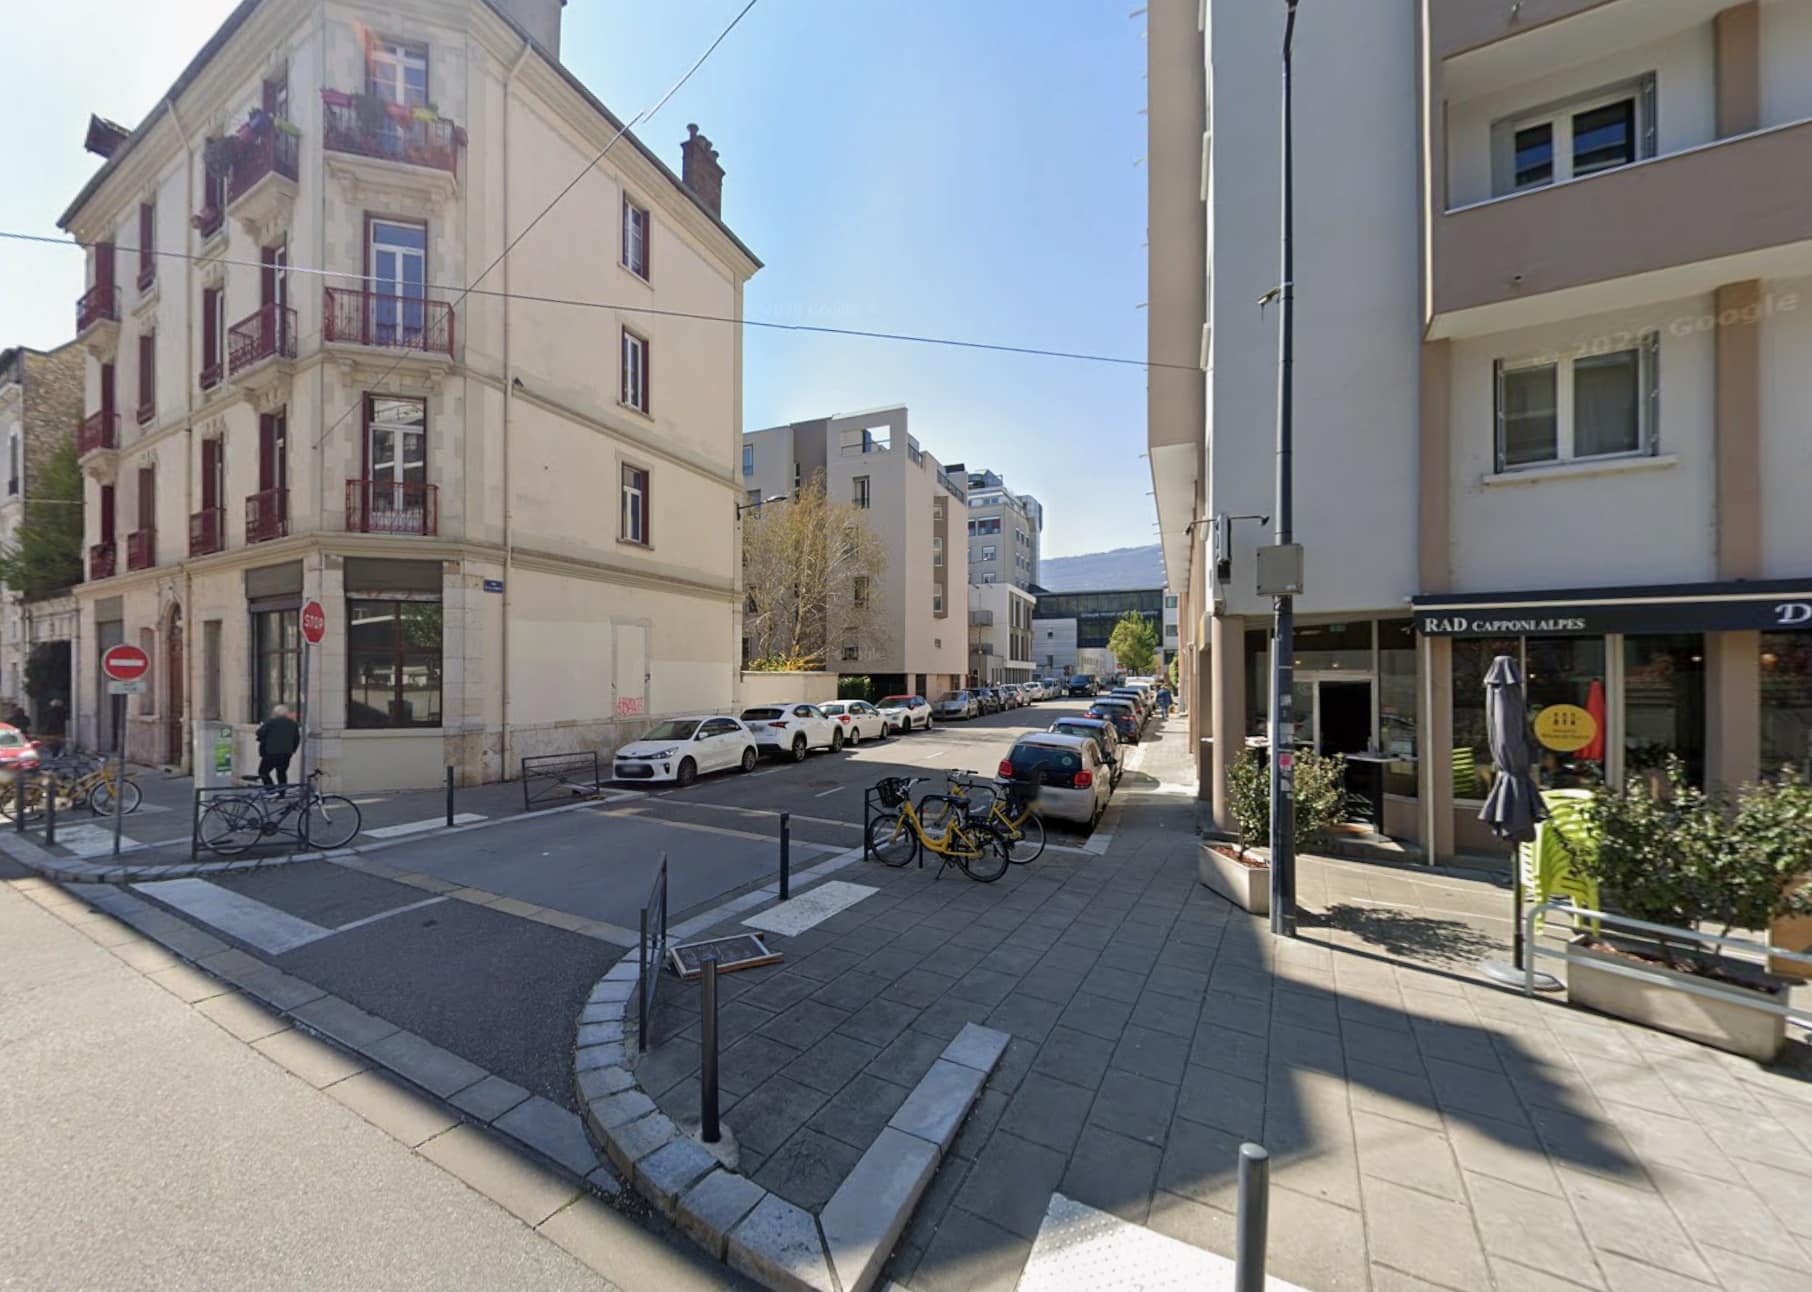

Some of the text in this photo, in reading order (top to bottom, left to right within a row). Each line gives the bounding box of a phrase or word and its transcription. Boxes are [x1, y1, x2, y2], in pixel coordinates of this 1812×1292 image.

[304, 614, 323, 629] STOP
[1424, 617, 1586, 632] RAD CAPPONI ALPES
